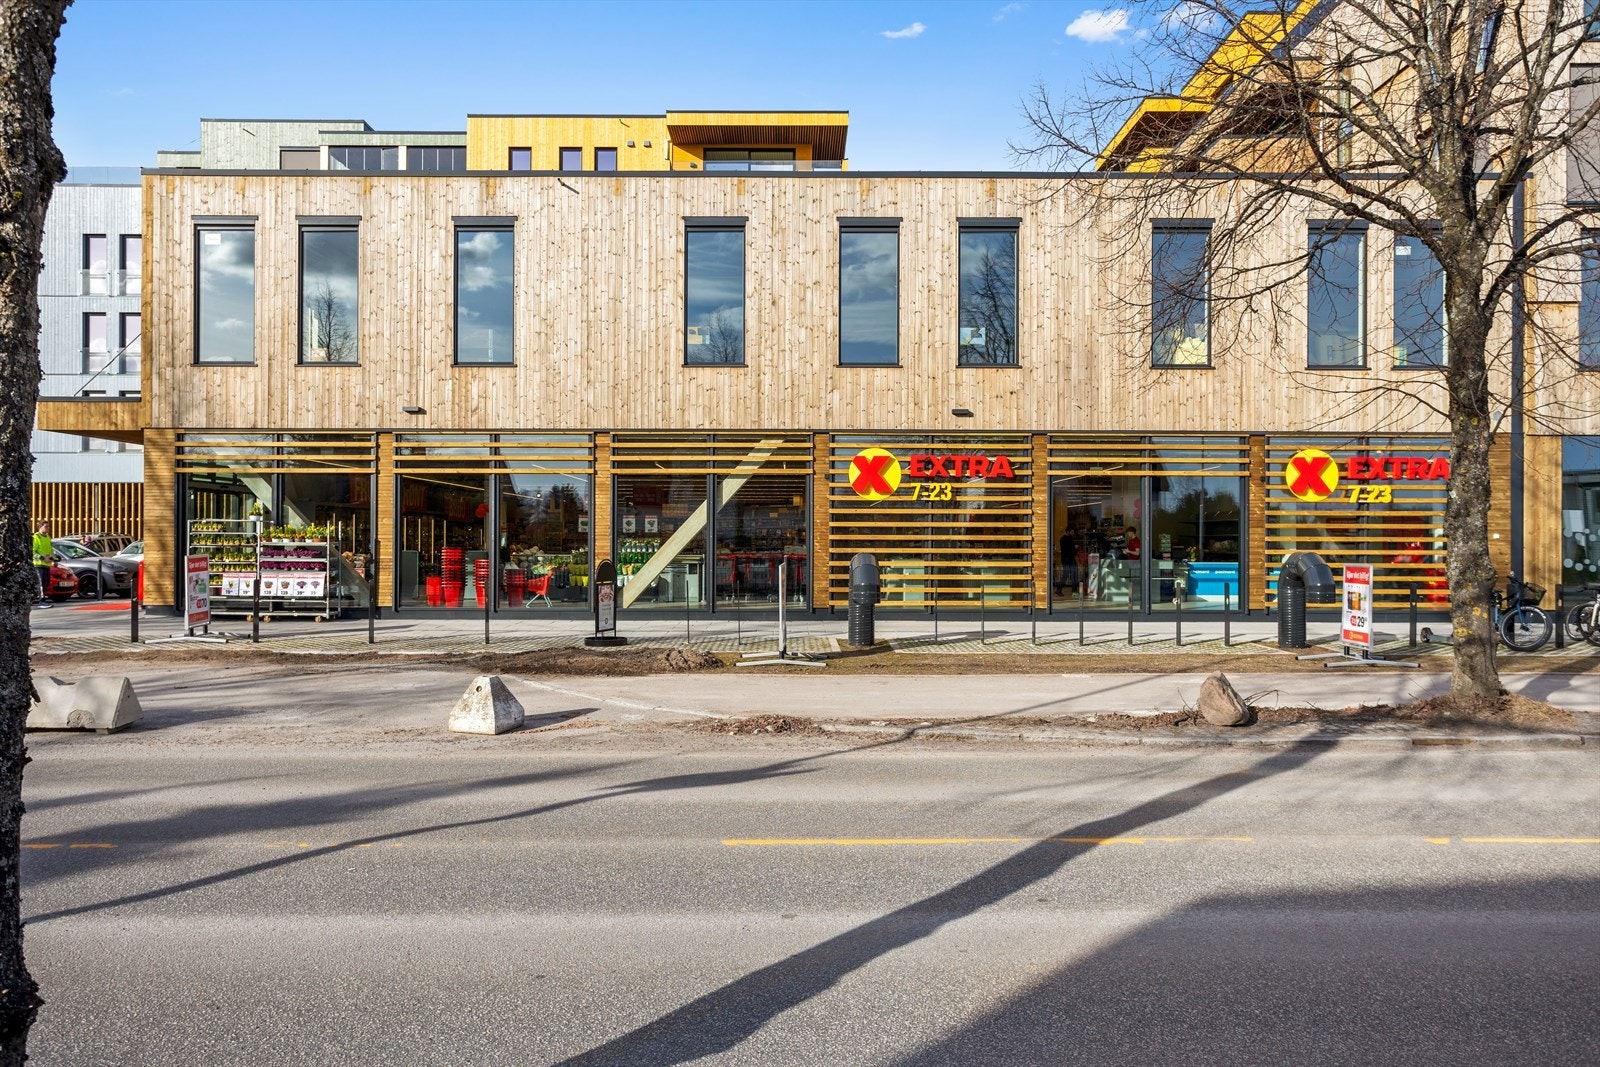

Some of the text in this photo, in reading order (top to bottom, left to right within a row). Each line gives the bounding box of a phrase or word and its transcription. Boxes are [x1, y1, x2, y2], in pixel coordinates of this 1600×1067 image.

[852, 455, 895, 495] X
[910, 454, 1013, 478] EXTRA
[1289, 456, 1333, 496] X
[1348, 456, 1450, 481] EXTRA
[911, 482, 953, 501] 7-23
[1348, 484, 1393, 504] 7-23
[1357, 616, 1364, 627] 29
